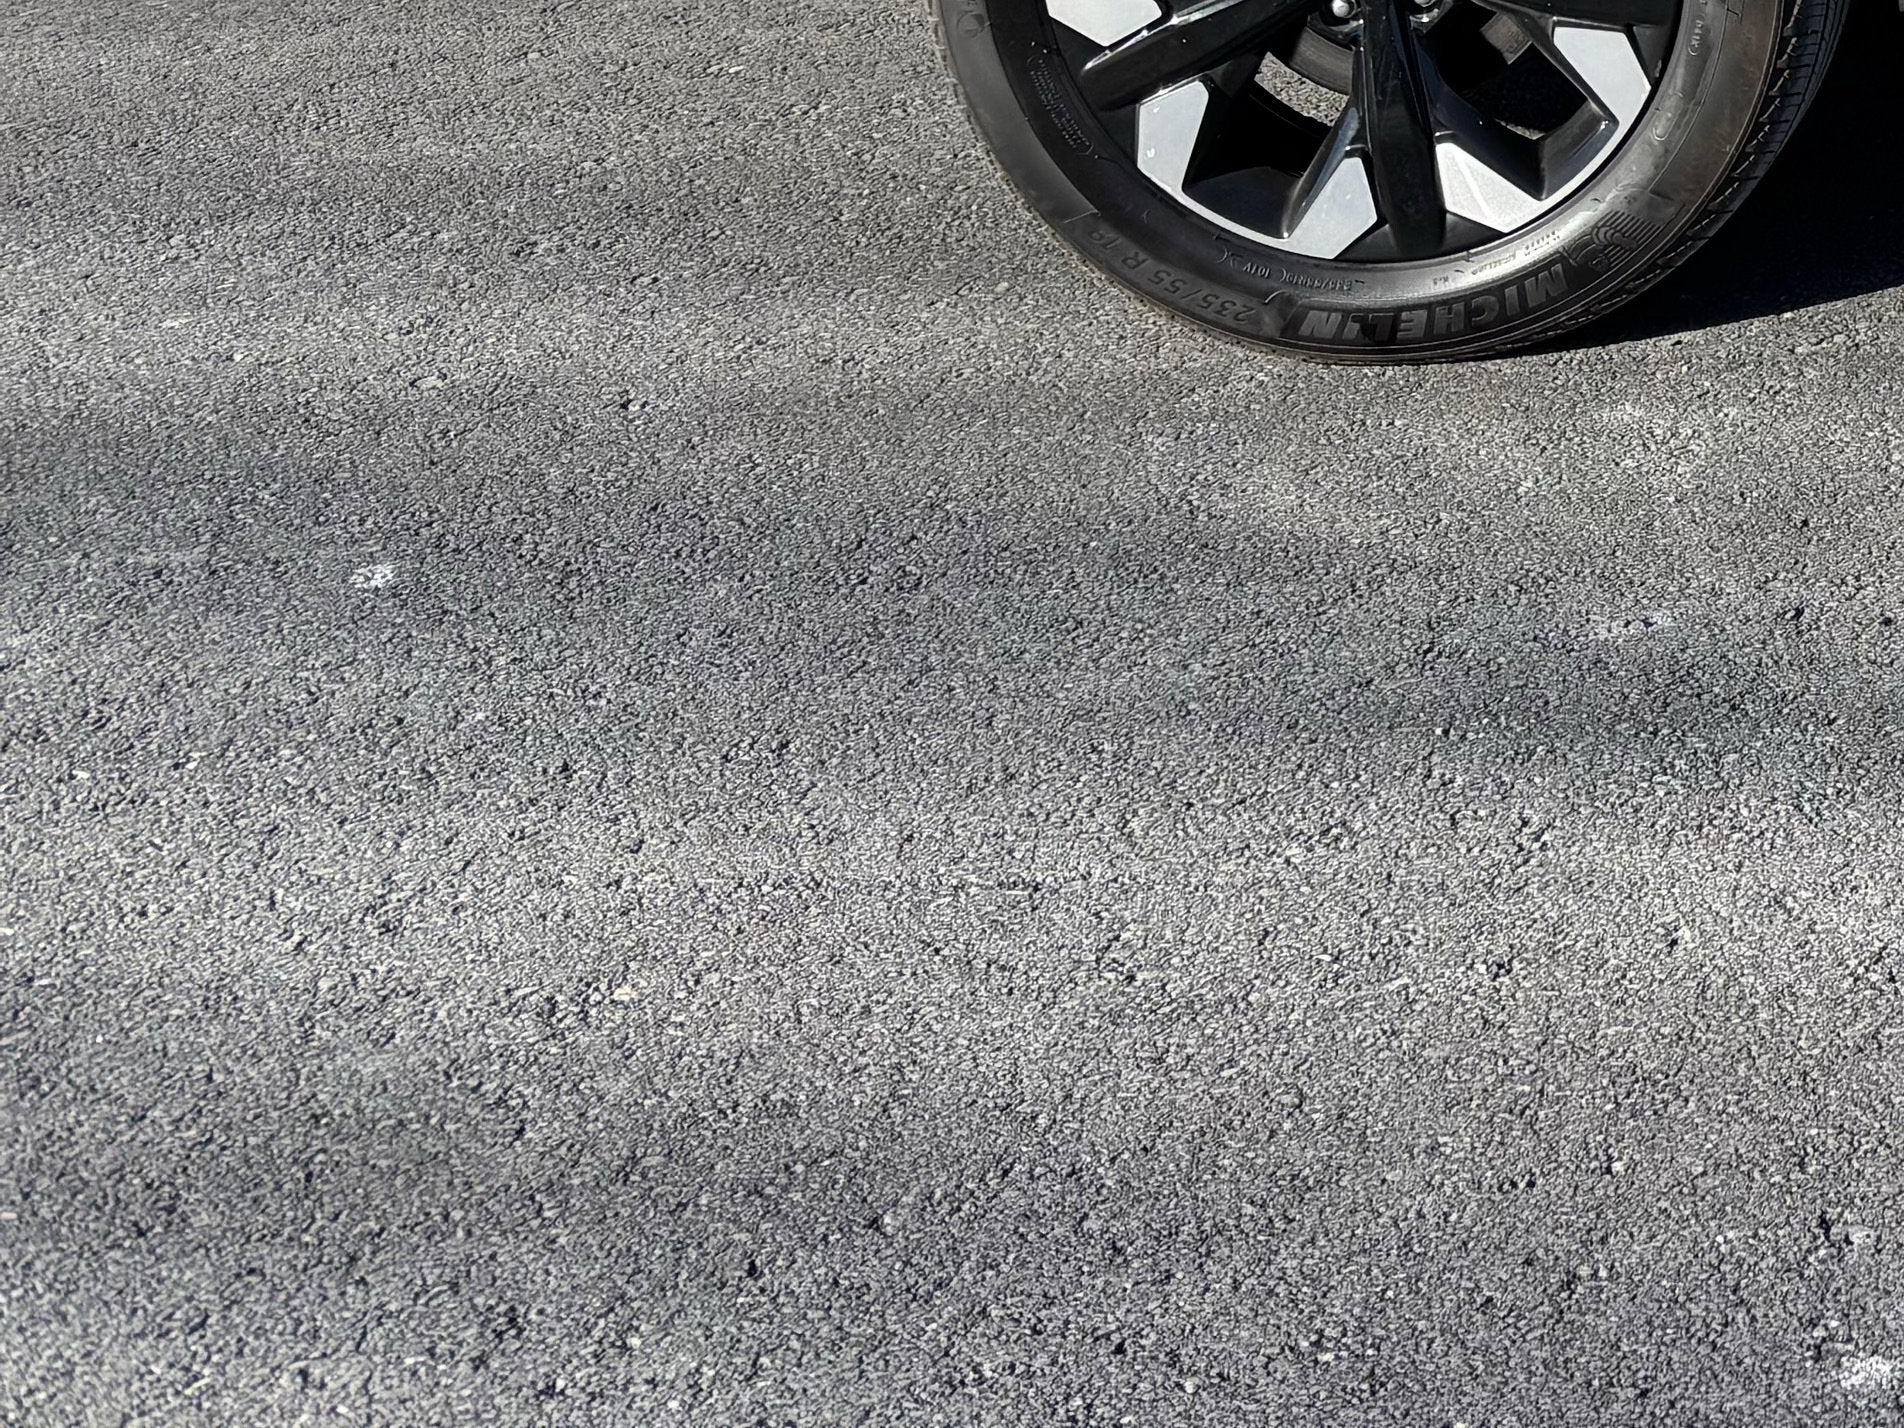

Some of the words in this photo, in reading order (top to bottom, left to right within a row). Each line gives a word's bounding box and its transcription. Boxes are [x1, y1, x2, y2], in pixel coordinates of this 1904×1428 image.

[1120, 250, 1151, 271] R
[1147, 269, 1257, 324] 235/55
[1300, 262, 1569, 340] MICHELIN
